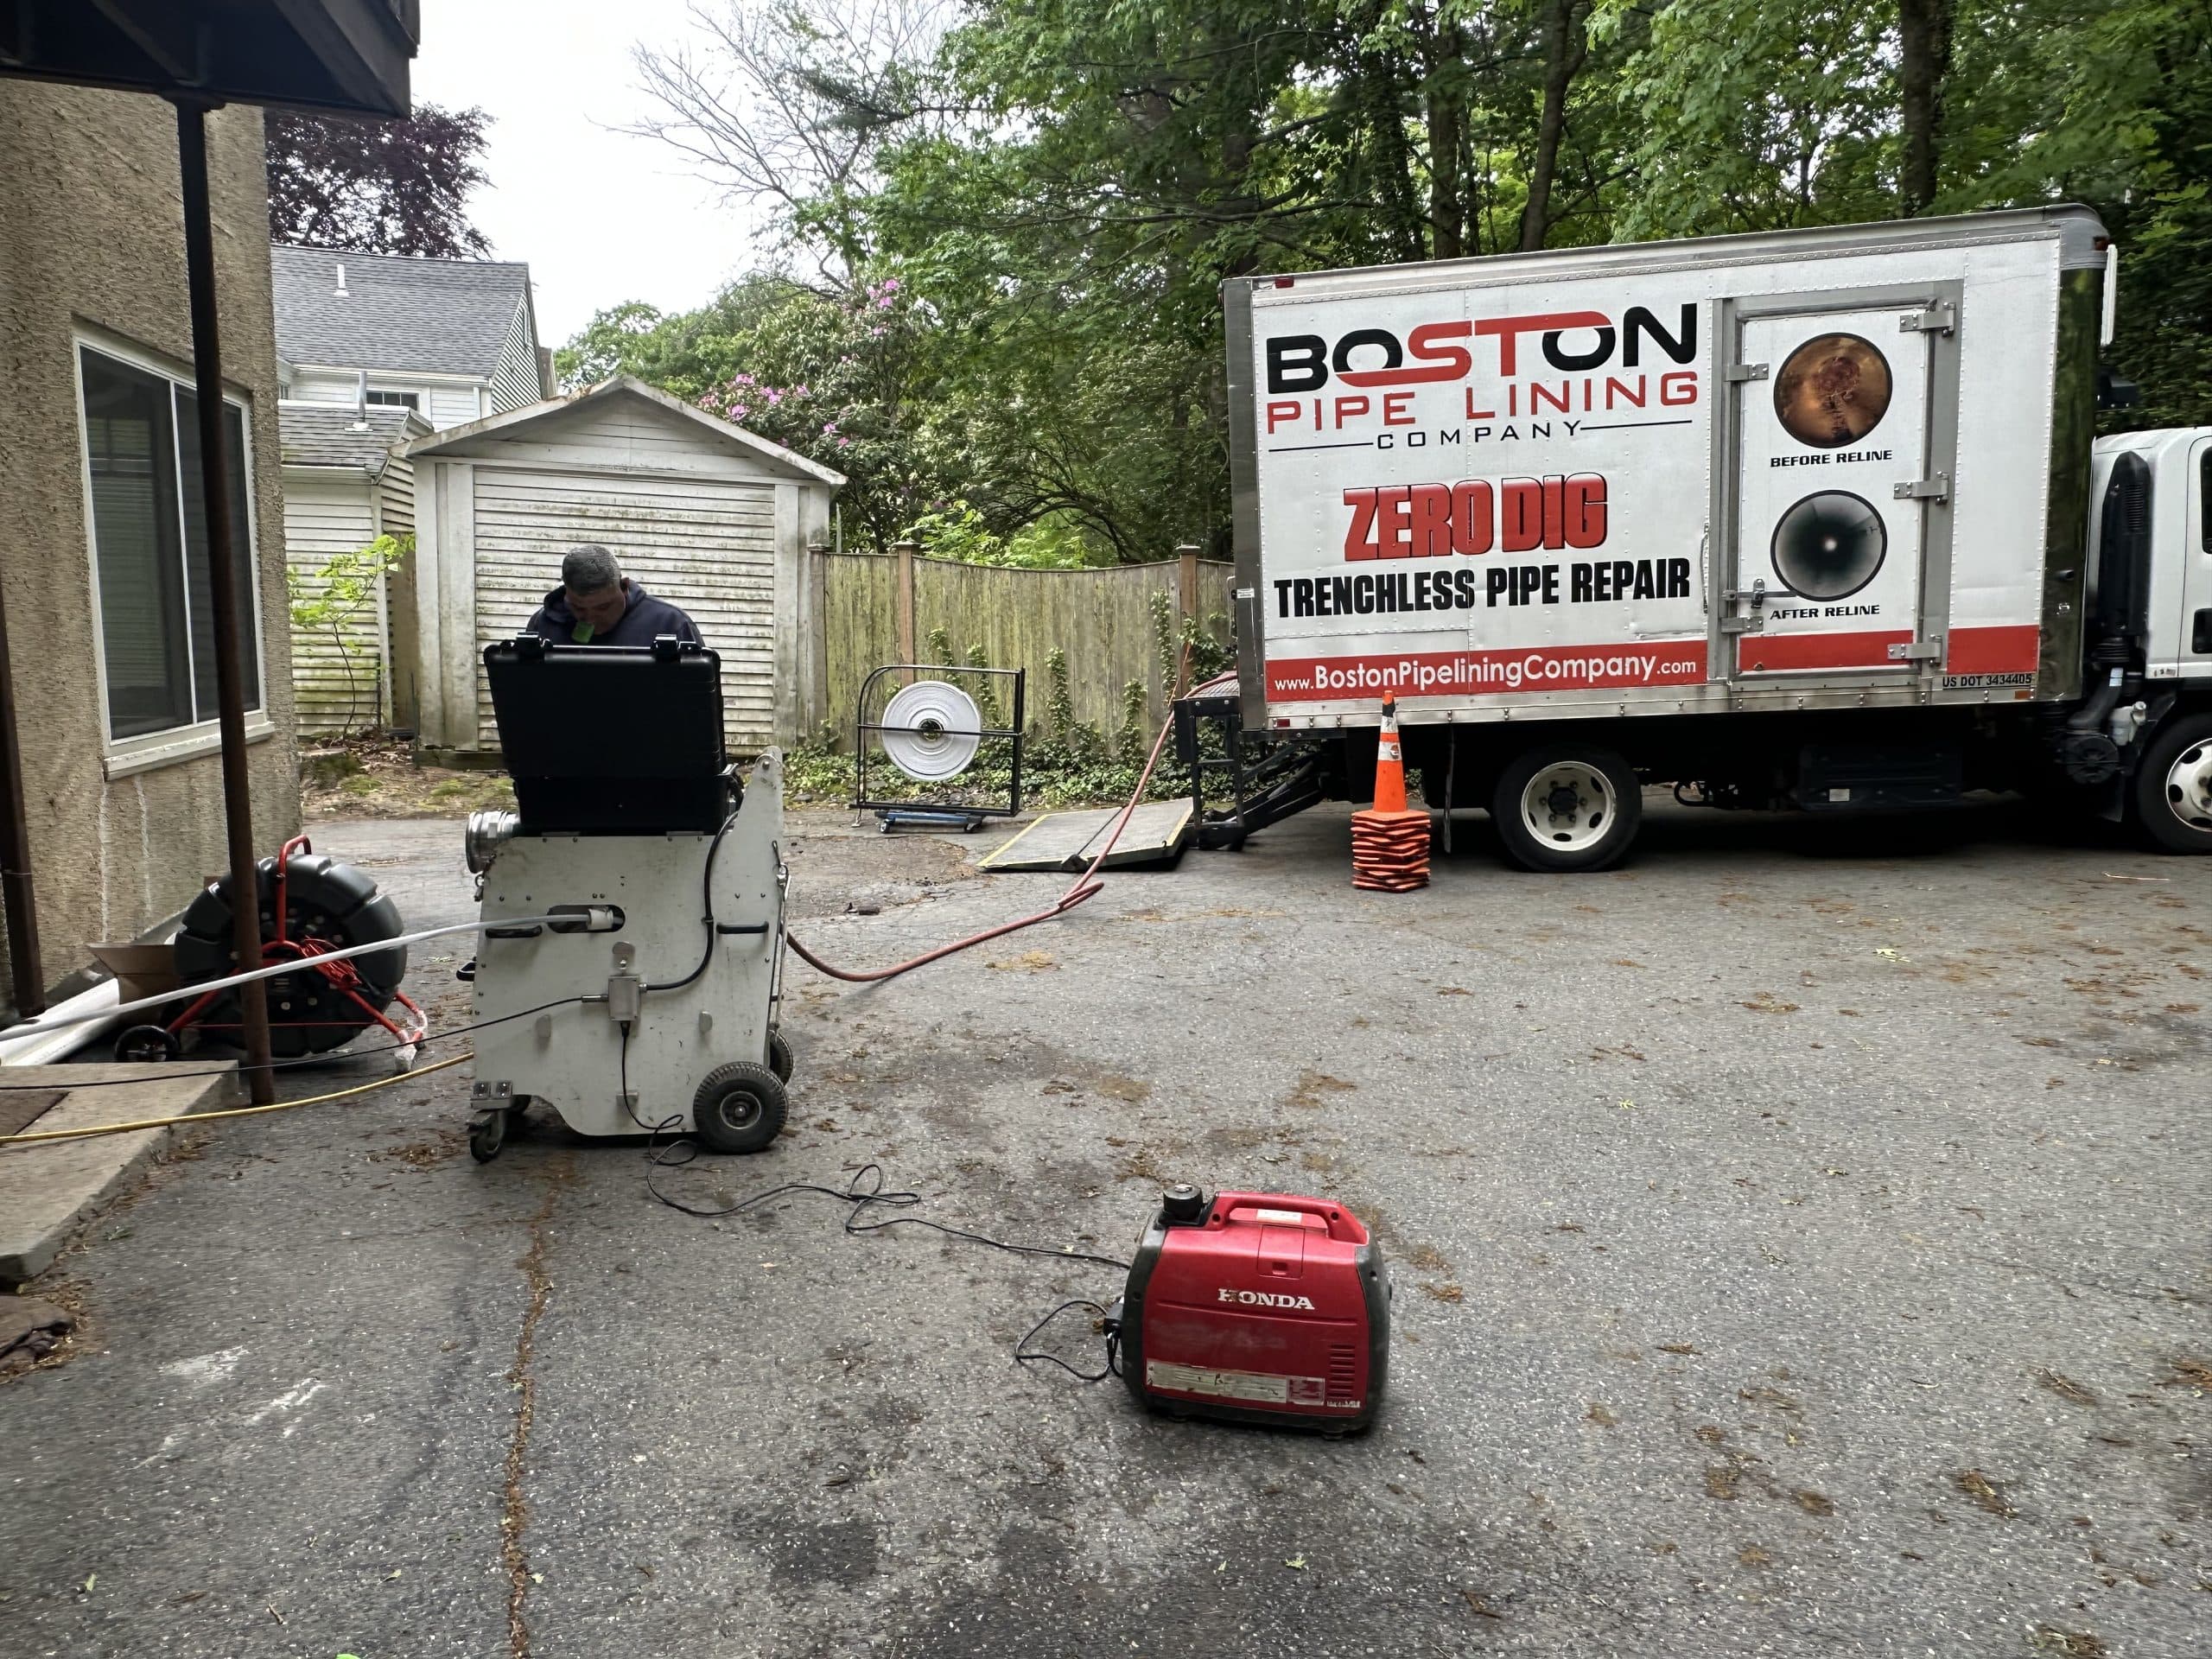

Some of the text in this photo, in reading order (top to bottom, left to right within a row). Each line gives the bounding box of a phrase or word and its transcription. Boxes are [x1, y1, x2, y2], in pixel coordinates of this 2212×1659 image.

[1266, 302, 1697, 394] BOSTON
[1268, 371, 1698, 434] PIPE LINING
[1377, 420, 1581, 449] COMPANY
[1770, 450, 1892, 467] BEFORE RELINE
[1344, 472, 1608, 562] ZERO DIG
[1274, 557, 1690, 618] TRENCHLESS PIPE REPAIR
[1770, 605, 1880, 620] AFTER RELINE
[1274, 655, 1696, 691] www.BostonPipeliningCompany.com
[1942, 674, 2032, 687] US DOT 3434405
[1217, 1288, 1315, 1310] HONDA
